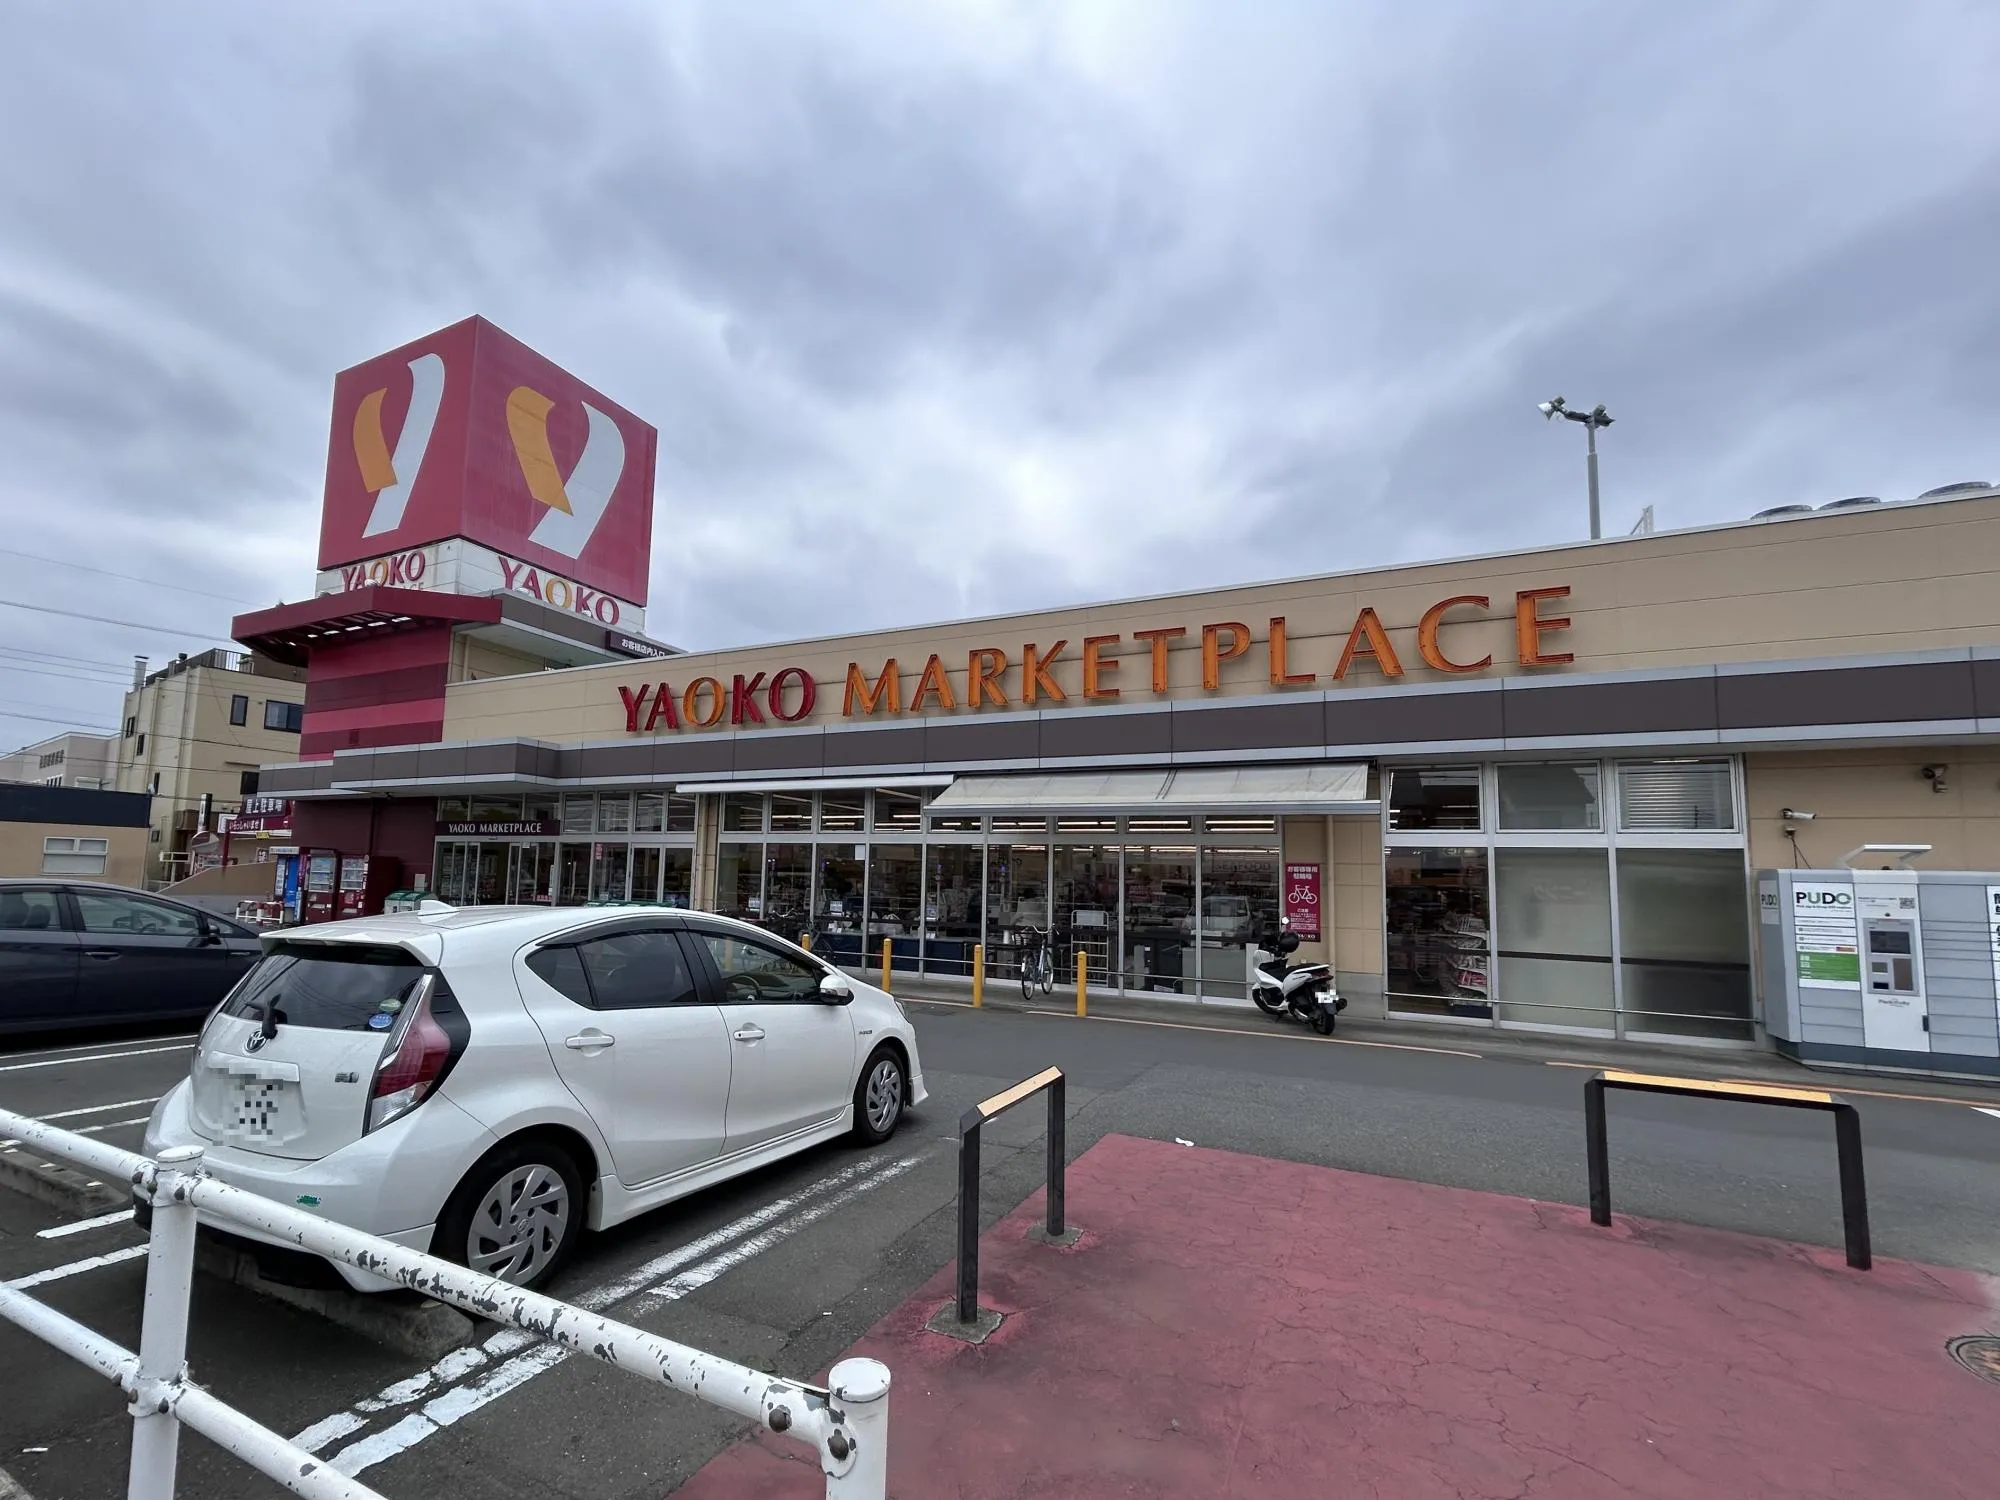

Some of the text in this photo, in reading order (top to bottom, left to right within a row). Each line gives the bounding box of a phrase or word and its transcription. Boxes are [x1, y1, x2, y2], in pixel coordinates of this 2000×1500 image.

[341, 550, 425, 592] YAOKO
[498, 556, 620, 626] YAOKO
[617, 584, 1574, 733] YAOKO MARKETPLACE
[245, 797, 283, 814] 屋上駐車場
[448, 822, 542, 834] YAOKO MARKETPLACE
[1795, 891, 1852, 905] PUDO
